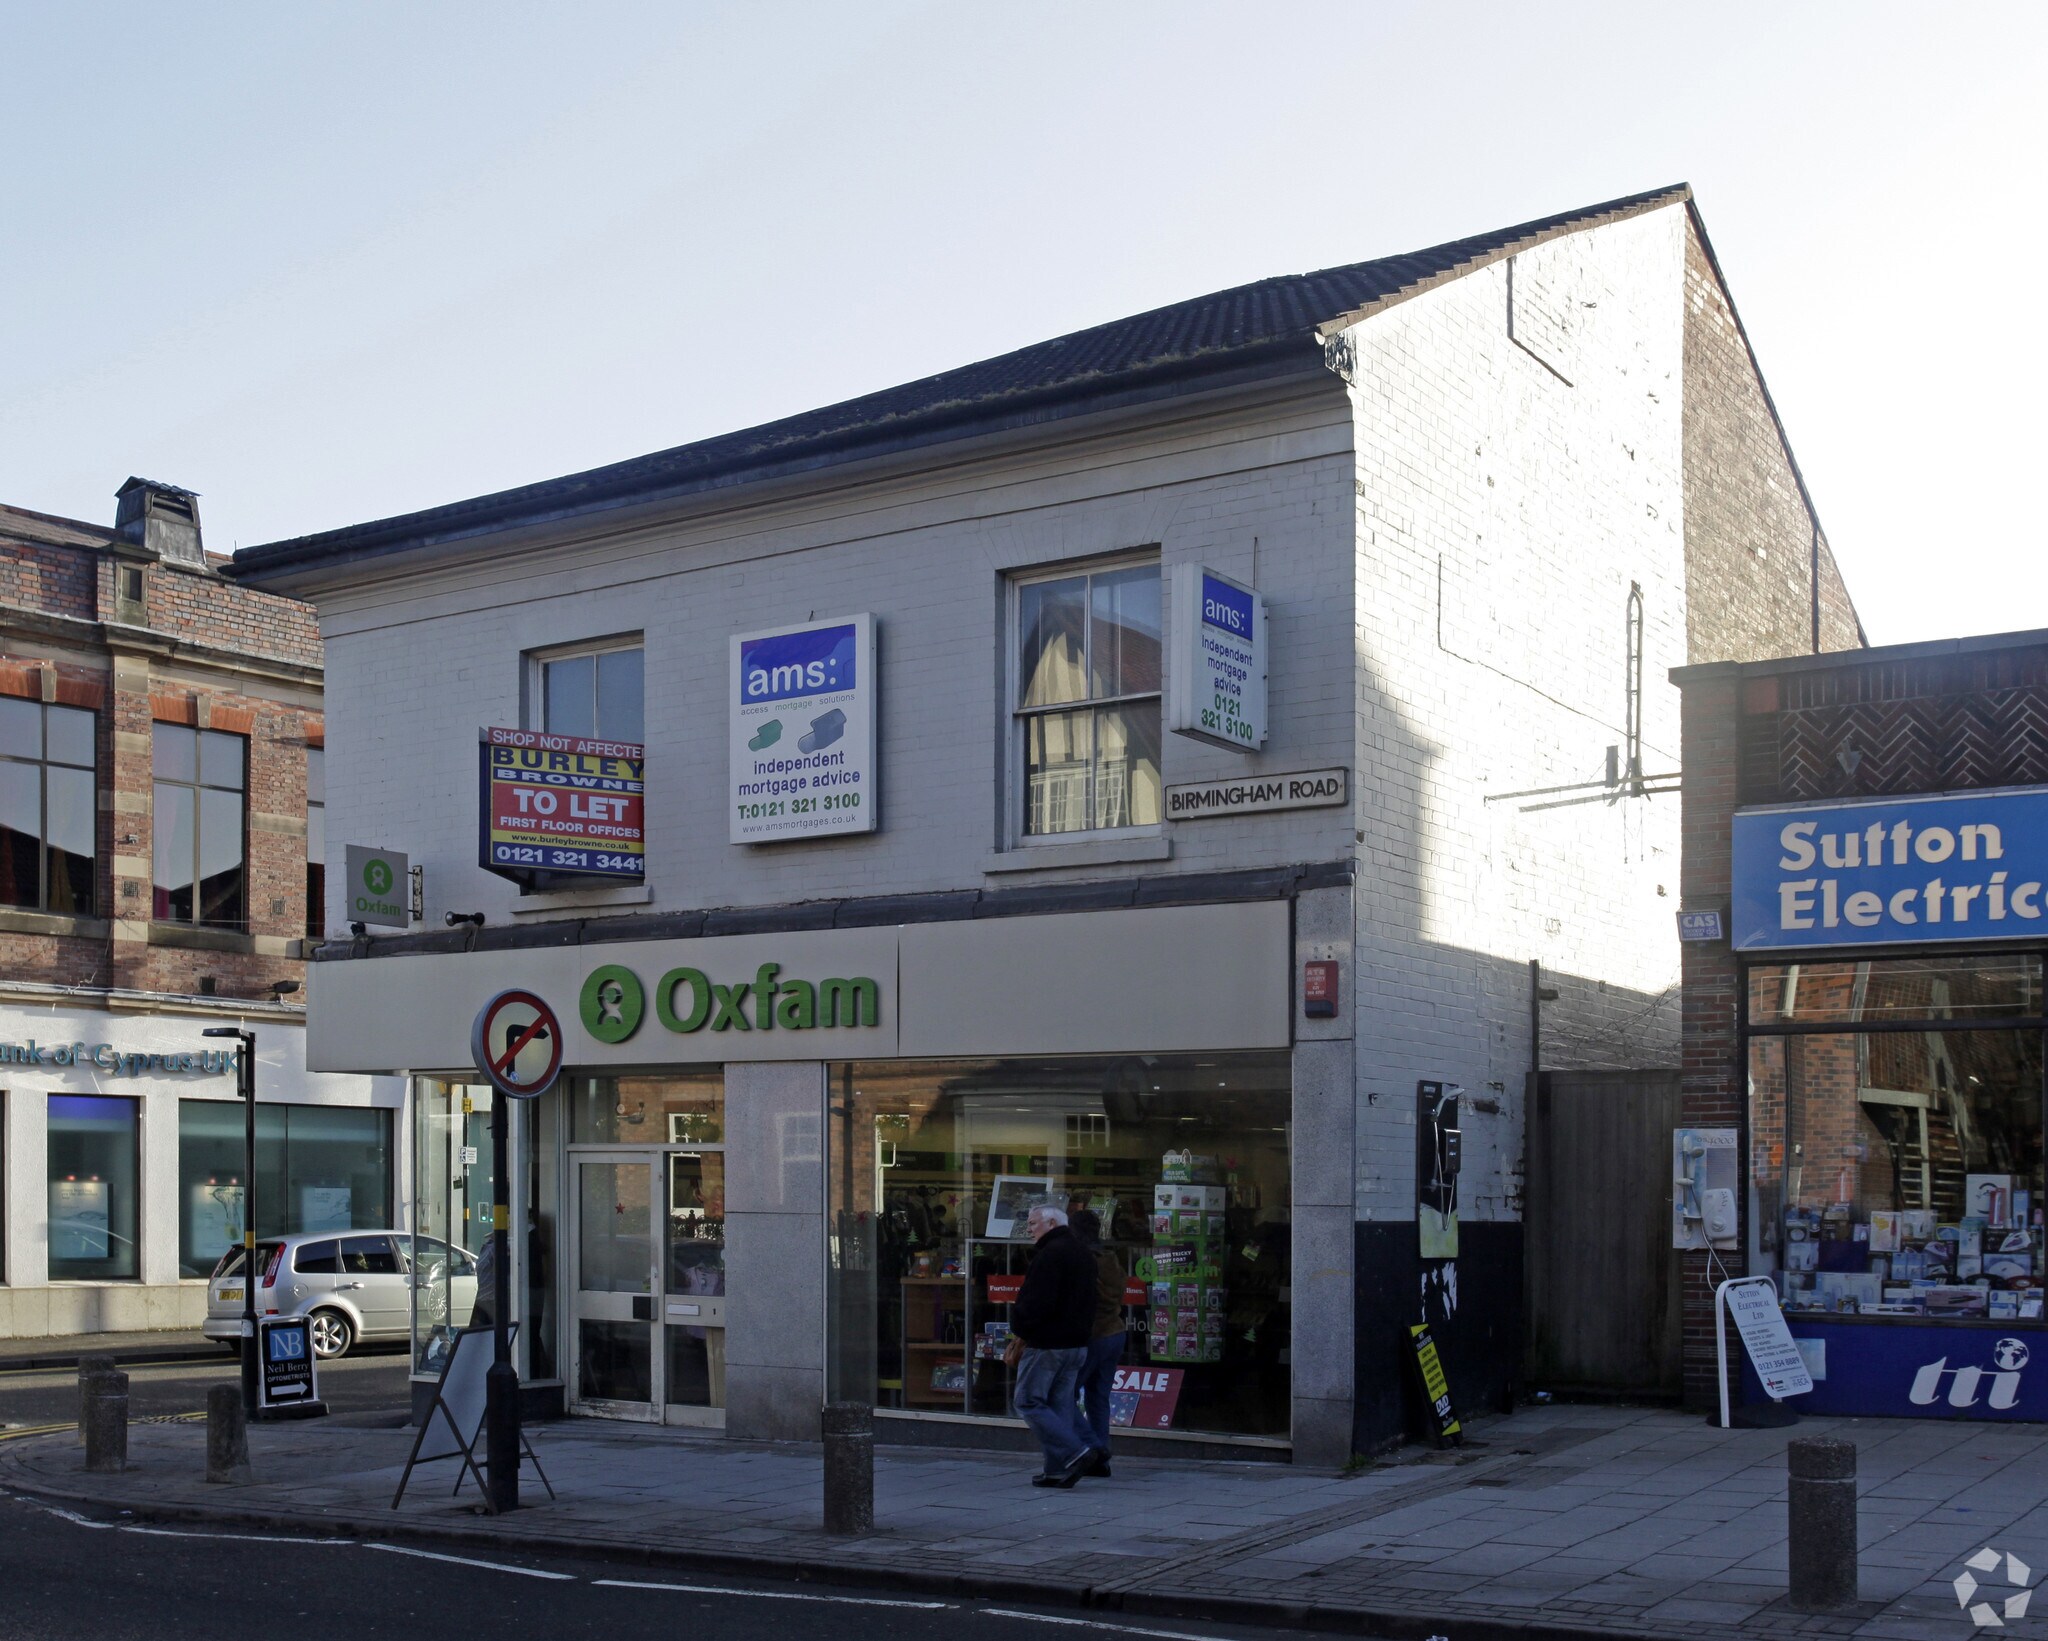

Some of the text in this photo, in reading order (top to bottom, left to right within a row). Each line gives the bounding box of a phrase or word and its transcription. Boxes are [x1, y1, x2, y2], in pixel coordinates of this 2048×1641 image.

[1205, 598, 1245, 631] ams:
[747, 658, 837, 697] ams:
[1207, 656, 1247, 681] mortgage
[1214, 676, 1241, 696] advice
[741, 693, 856, 716] access mortgage solutions
[1214, 693, 1241, 718] 0121
[1201, 708, 1253, 742] 321 3100
[492, 730, 535, 747] SHOP
[540, 735, 572, 751] NOT
[493, 747, 644, 779] BURLEY
[754, 750, 845, 776] independent
[497, 769, 644, 792] BROWNE
[738, 770, 861, 796] mortgage advice
[513, 788, 629, 822] TO LET
[737, 792, 860, 820] T:0121 321 3100
[1171, 778, 1340, 811] BIRMINGHAM ROAD
[500, 816, 640, 838] FIRST FLOOR OFFICES
[742, 814, 856, 833] www.amsmortgages.co.uk
[511, 834, 630, 850] www.burleybrowne.co.uk
[1778, 819, 2004, 871] Sutton
[497, 846, 644, 871] 0121 321 3441
[356, 897, 401, 917] Oxfam
[1778, 871, 2048, 930] Electric
[1682, 914, 1716, 928] CAS
[655, 962, 879, 1033] Oxfam
[55, 1041, 85, 1066] of
[93, 1043, 193, 1077] Cyprus
[200, 1049, 239, 1074] UK
[988, 1284, 1014, 1292] Further
[1125, 1286, 1144, 1295] lines.
[271, 1331, 302, 1358] NB
[267, 1361, 310, 1374] Neil Berry
[267, 1372, 310, 1383] OPTOMETRISTS
[1757, 1361, 1773, 1371] 0121
[1909, 1338, 2029, 1410] tti
[1111, 1369, 1170, 1392] SALE
[1435, 1394, 1449, 1414] DVD
